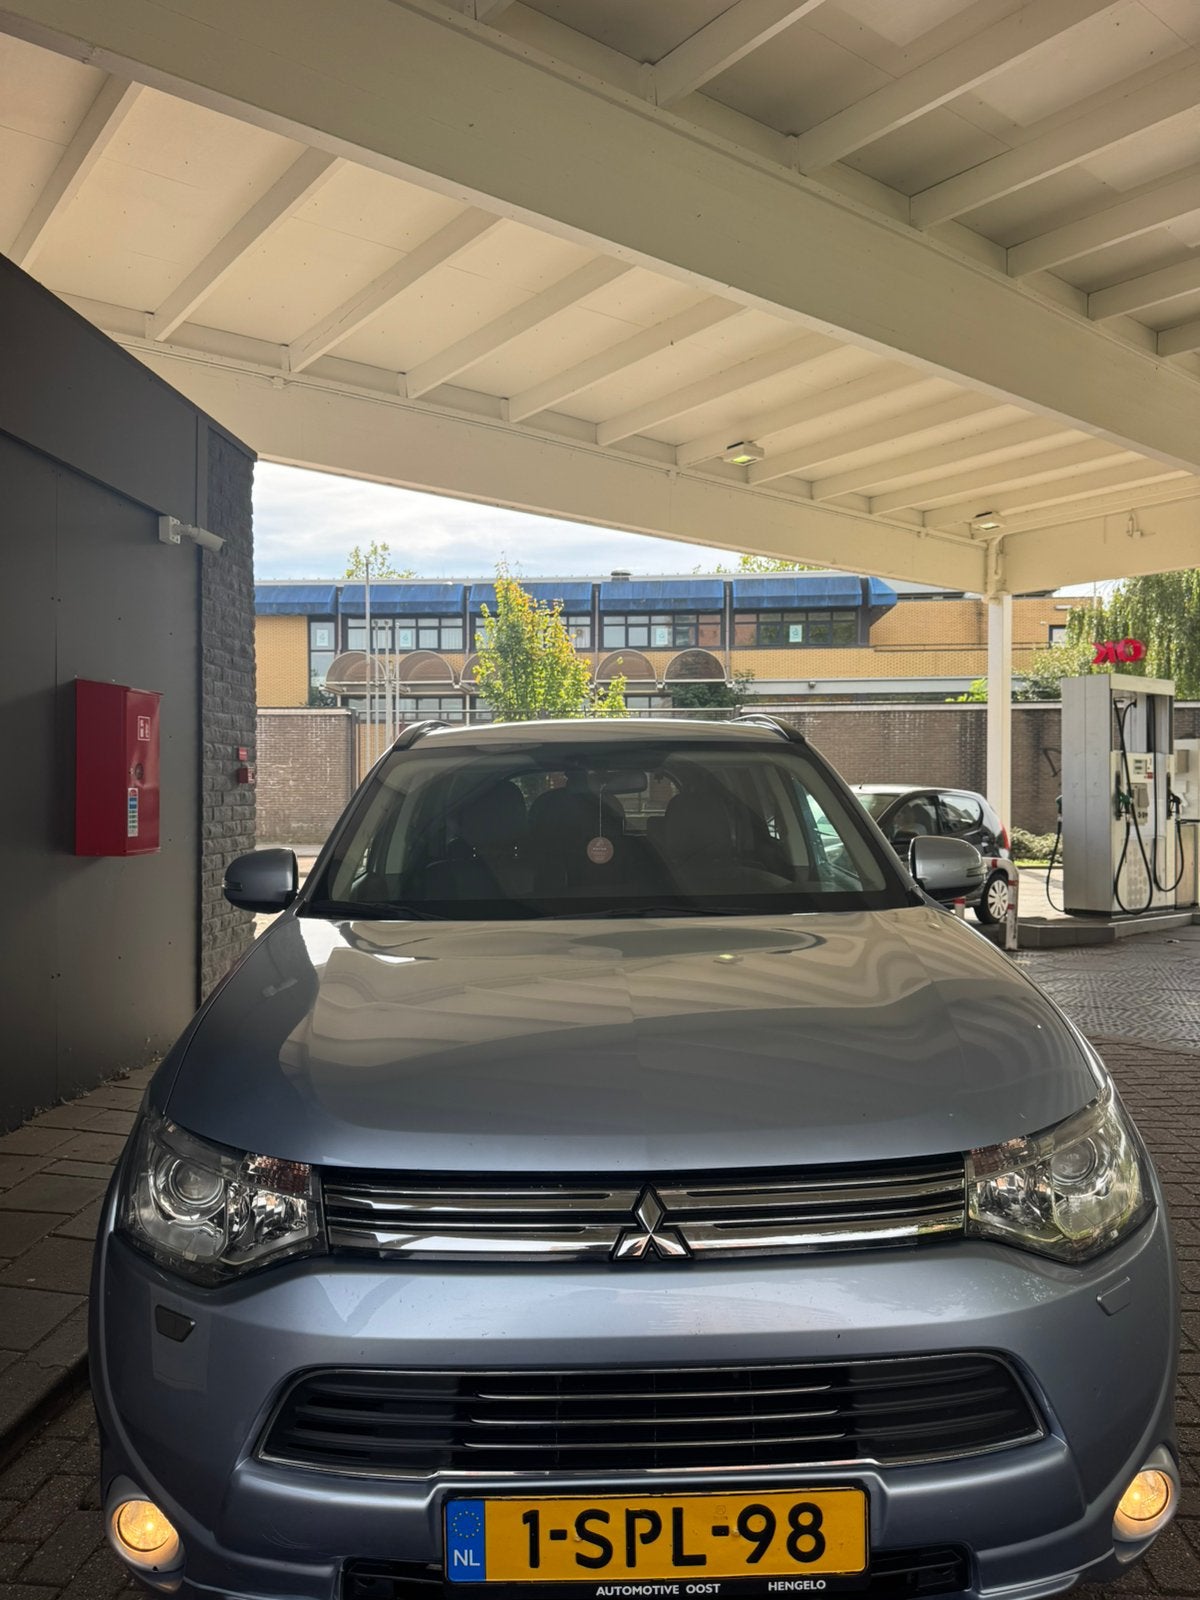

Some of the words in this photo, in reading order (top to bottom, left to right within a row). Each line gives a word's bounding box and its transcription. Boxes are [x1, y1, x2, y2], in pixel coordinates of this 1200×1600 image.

[522, 1502, 827, 1568] 1-SPL-98
[453, 1549, 480, 1567] NL
[595, 1584, 680, 1597] AUTOMOTIVE
[685, 1583, 721, 1595] OOST
[767, 1579, 826, 1592] HENGELO
